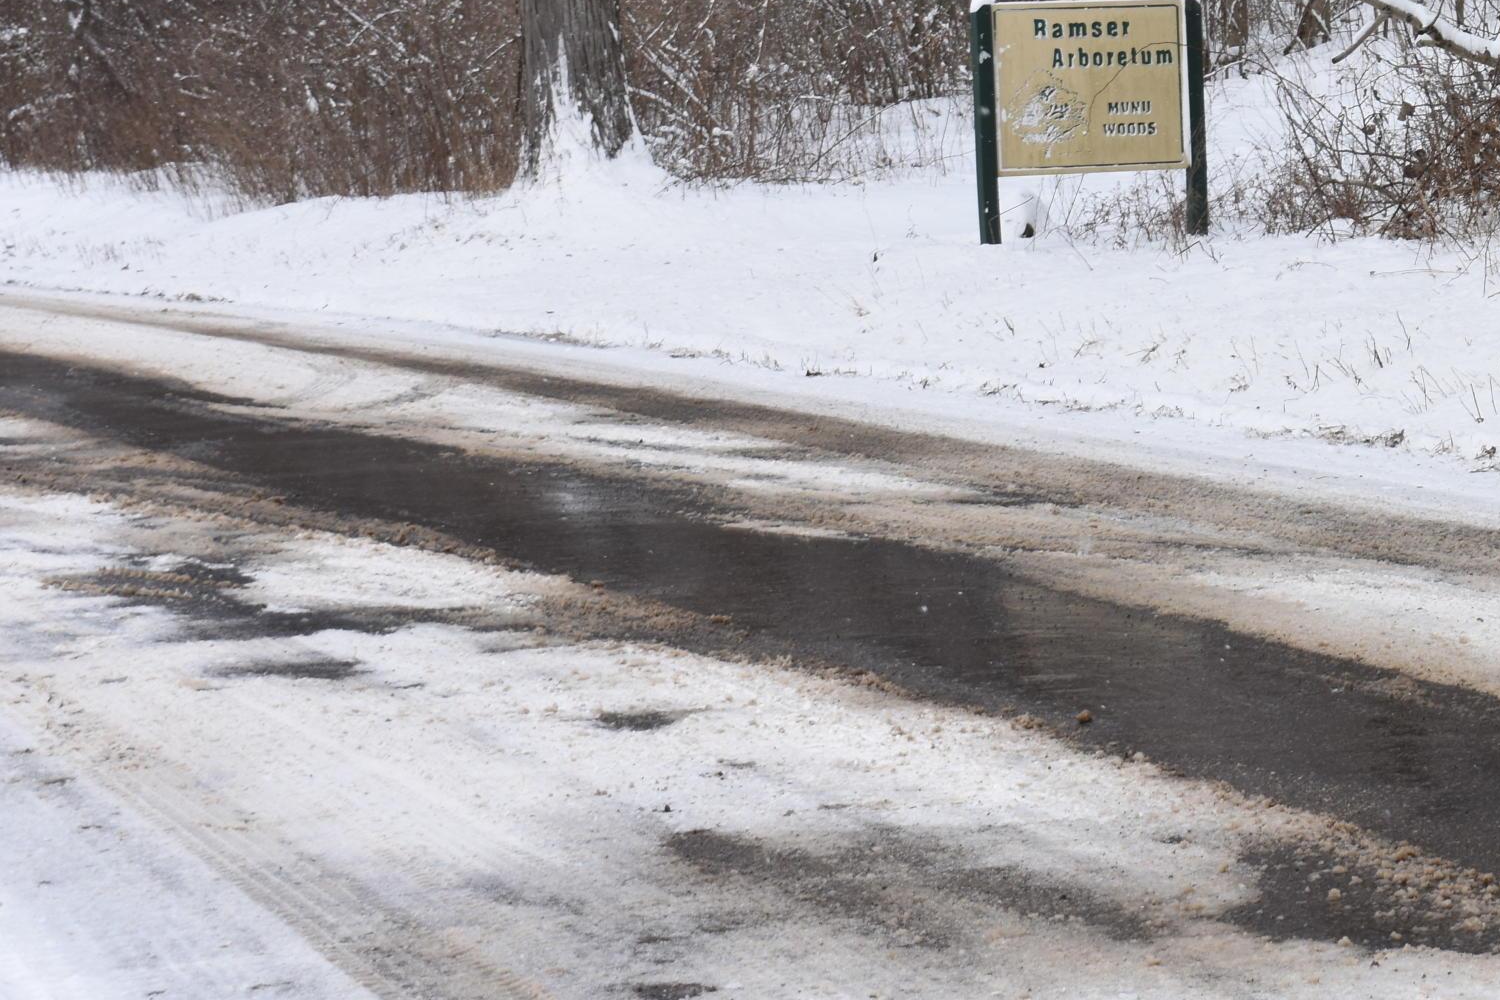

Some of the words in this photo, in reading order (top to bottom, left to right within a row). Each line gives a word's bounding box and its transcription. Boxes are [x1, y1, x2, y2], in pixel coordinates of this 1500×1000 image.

[1033, 18, 1130, 39] Ramser
[1052, 47, 1173, 68] Arboretum
[1103, 122, 1157, 136] WOODS
